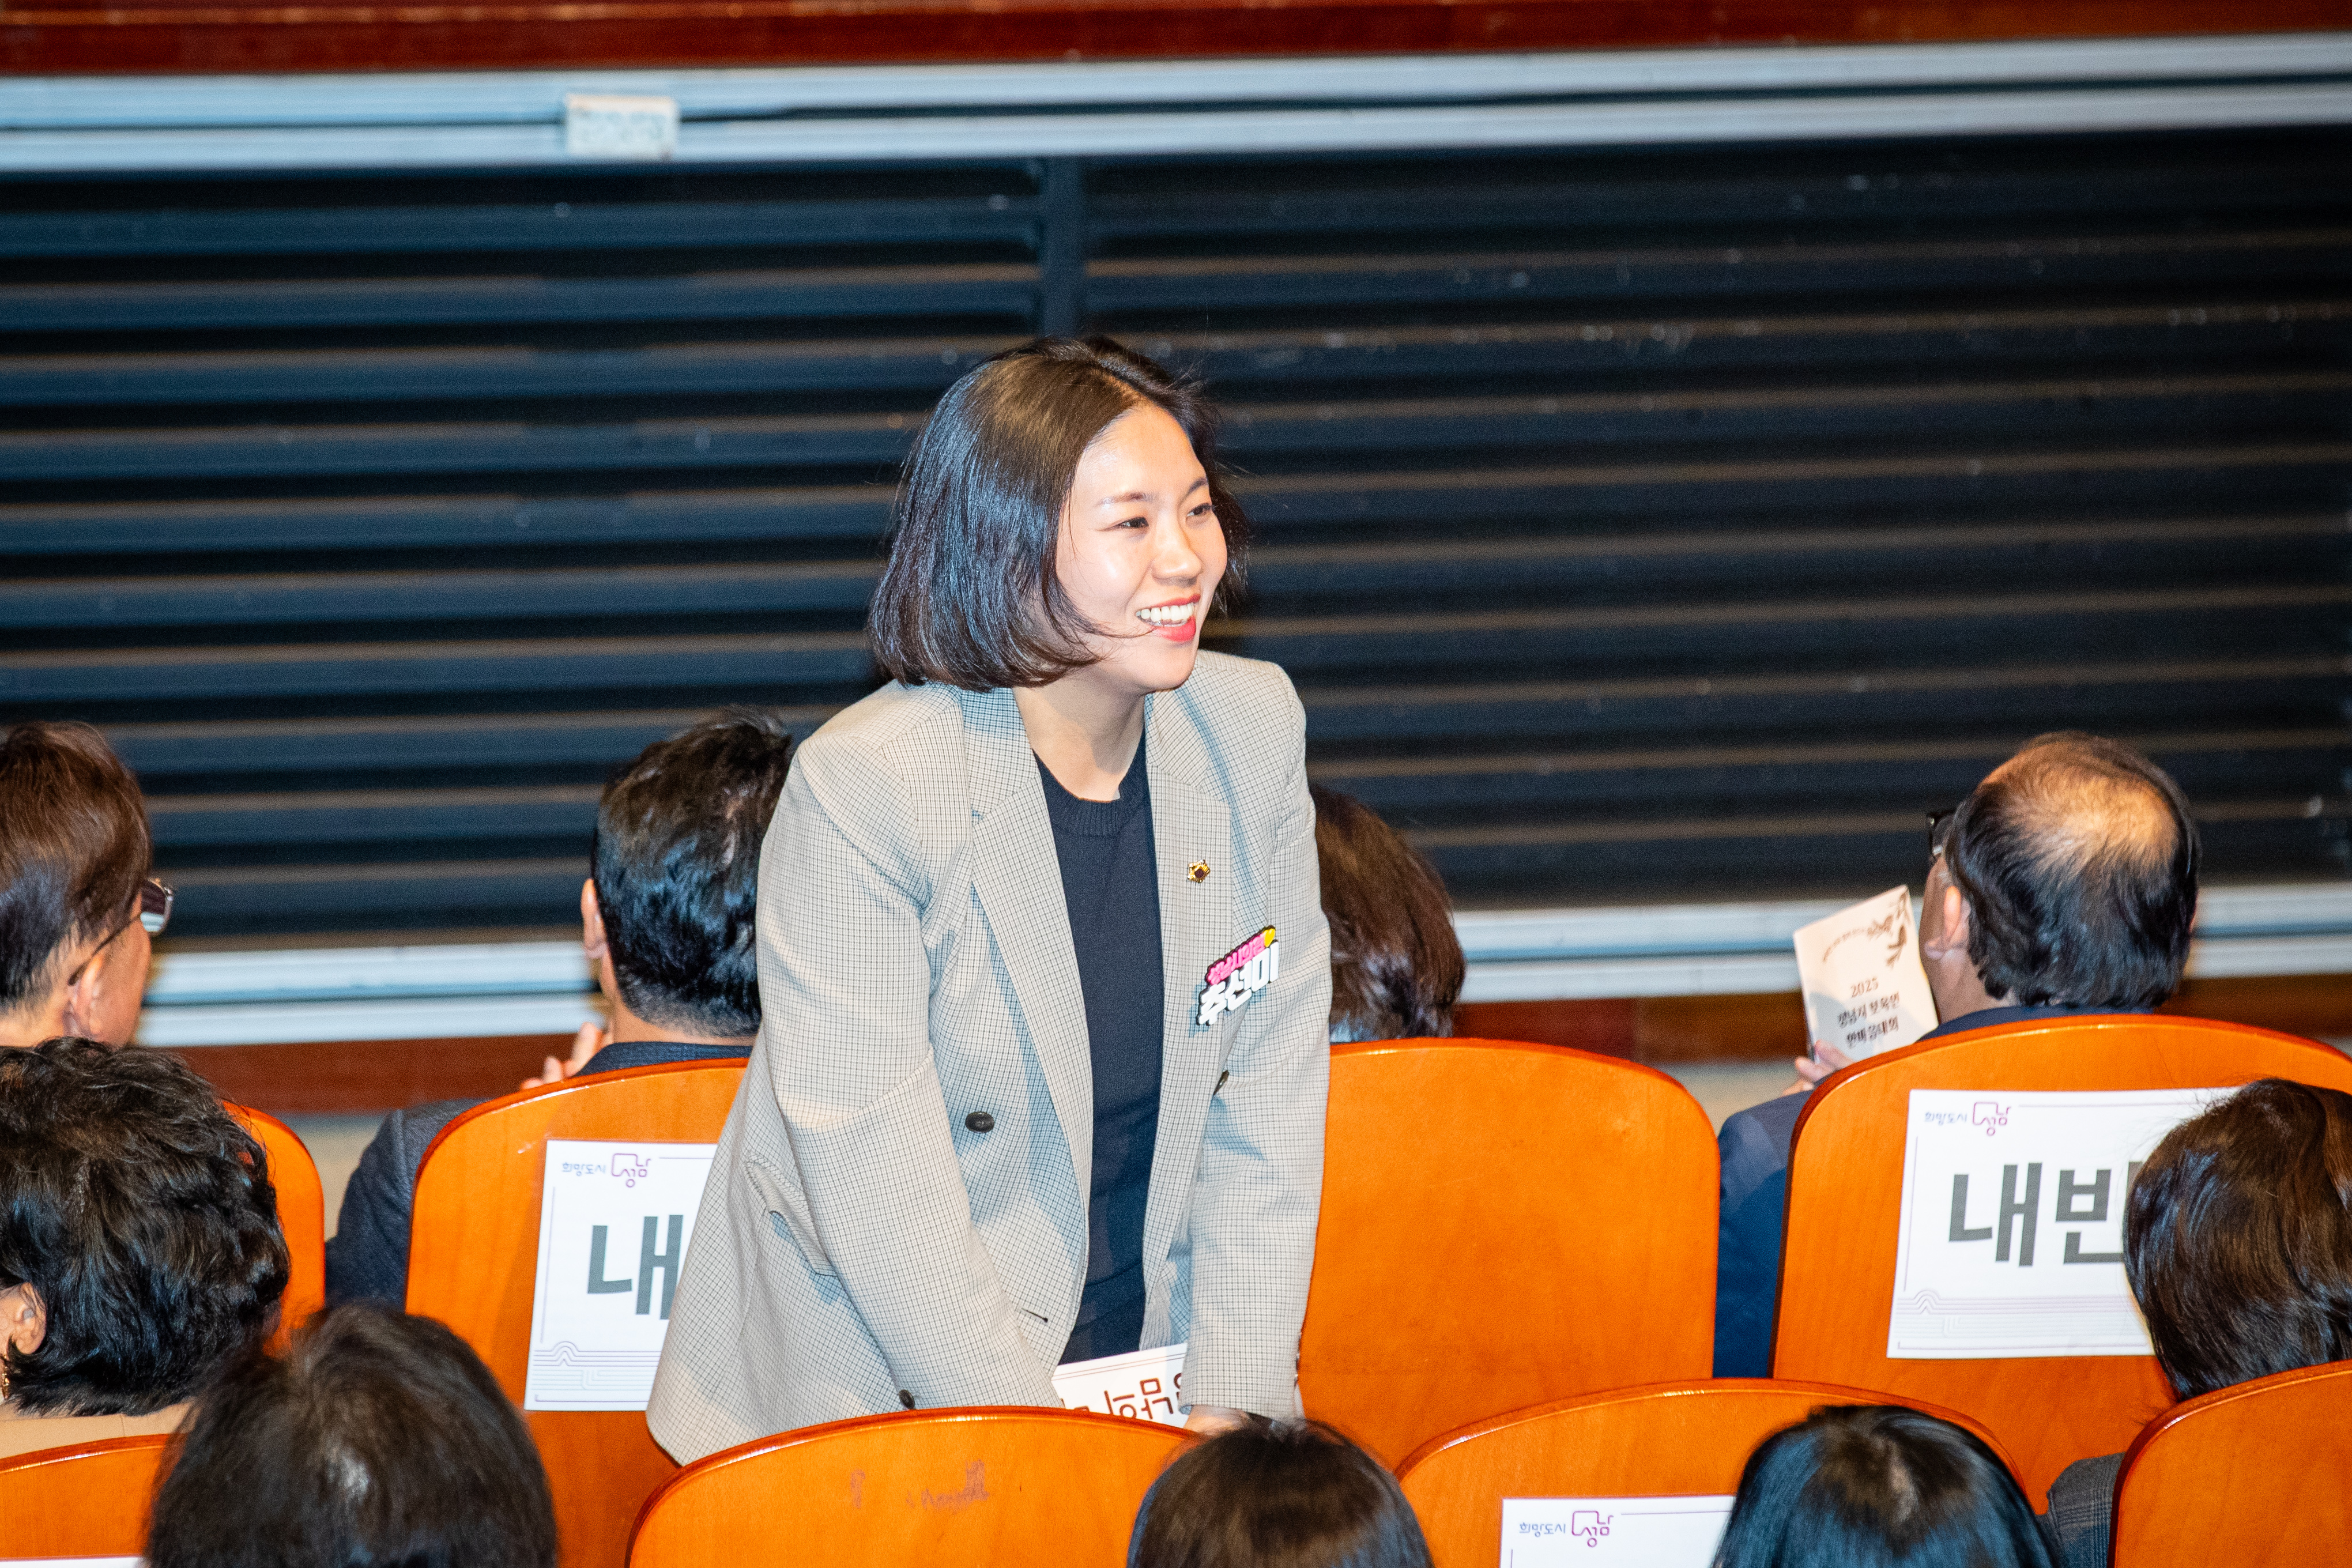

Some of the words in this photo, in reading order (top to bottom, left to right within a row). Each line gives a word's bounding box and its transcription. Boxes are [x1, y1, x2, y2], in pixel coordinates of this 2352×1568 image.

[1198, 941, 1279, 1026] 추선미
[1850, 977, 1879, 998] 2025
[1924, 1111, 1967, 1126] 희망도시
[1973, 1102, 2011, 1137] 성남
[561, 1162, 606, 1177] 희망도시
[611, 1153, 651, 1188] 성남
[1519, 1522, 1566, 1537] 희망도시
[1571, 1510, 1614, 1547] 성남
